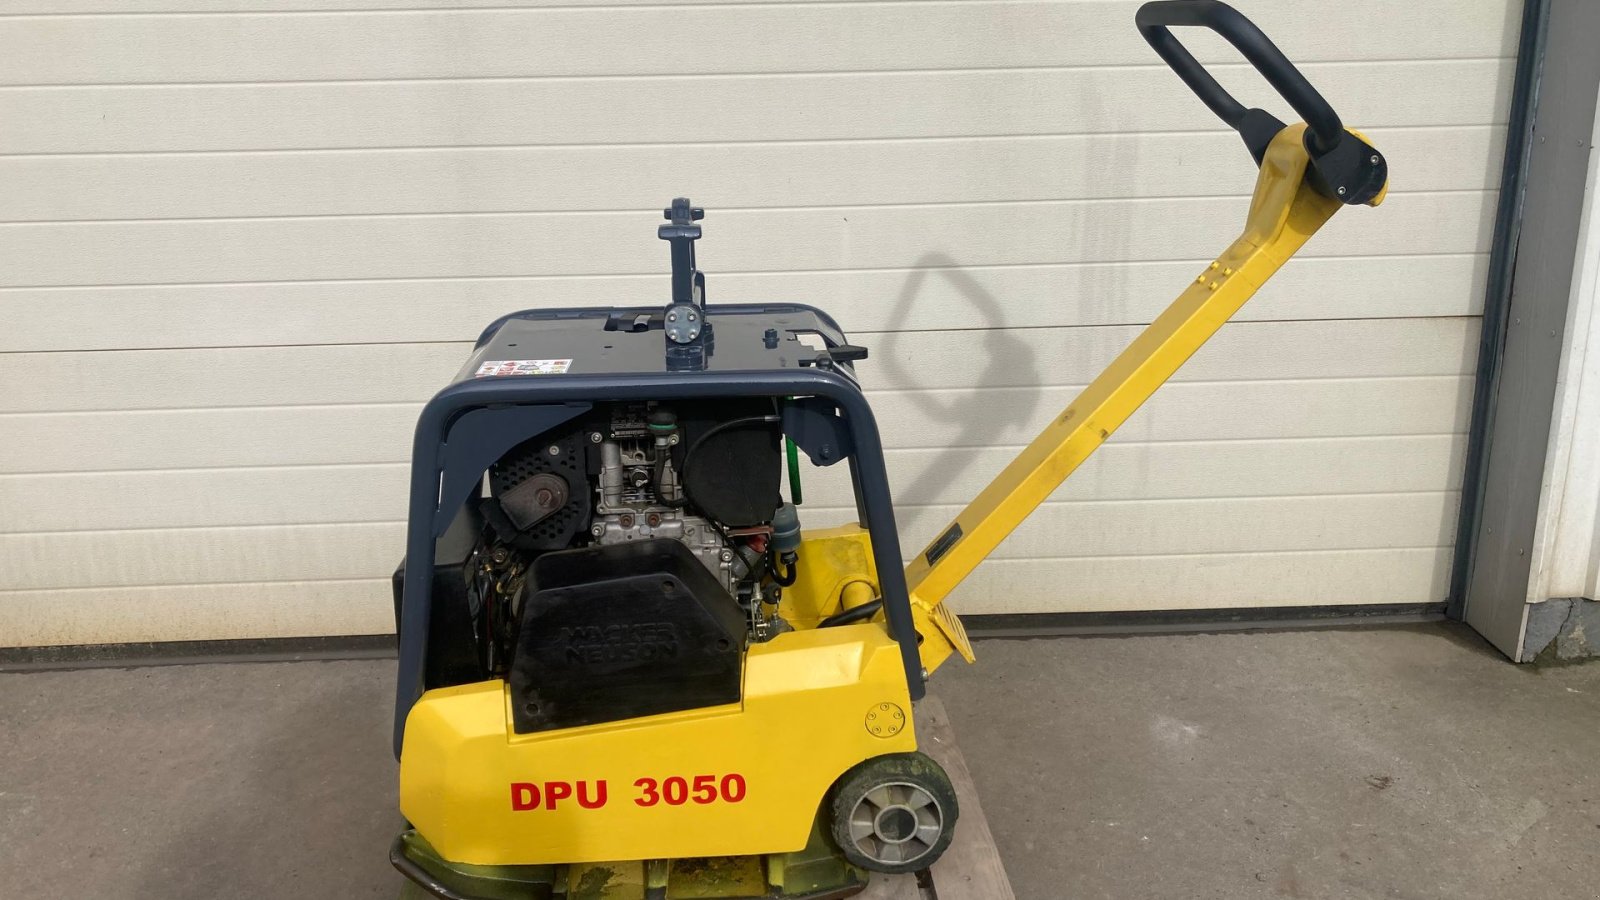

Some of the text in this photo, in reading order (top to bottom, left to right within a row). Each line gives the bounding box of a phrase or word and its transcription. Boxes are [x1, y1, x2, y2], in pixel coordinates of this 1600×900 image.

[557, 622, 677, 643] WACKER
[565, 640, 679, 664] NELSON
[510, 773, 747, 811] DPU 3050
